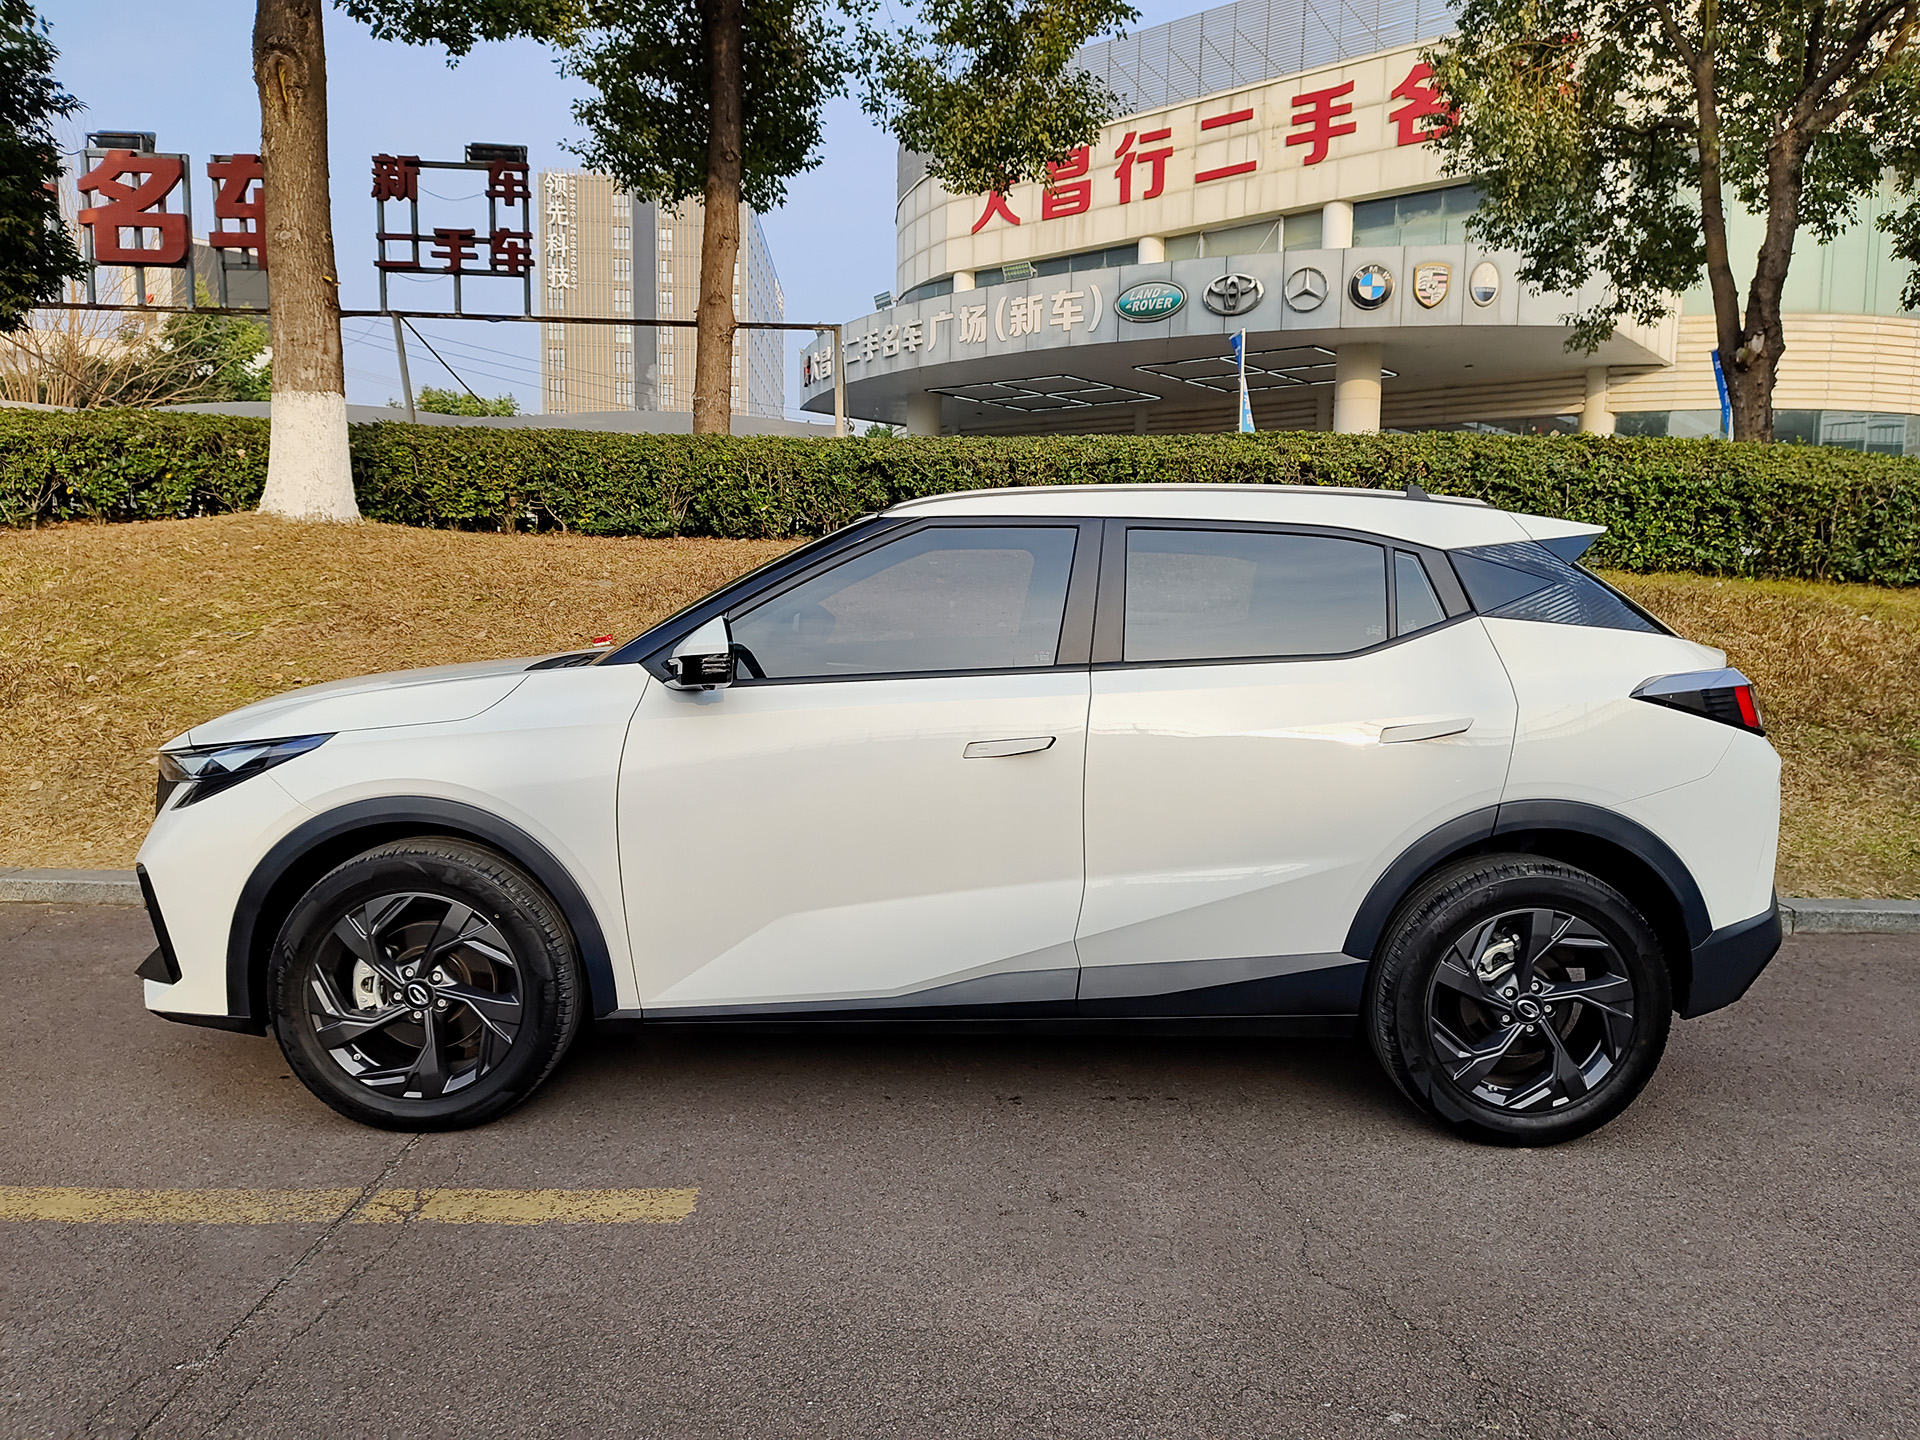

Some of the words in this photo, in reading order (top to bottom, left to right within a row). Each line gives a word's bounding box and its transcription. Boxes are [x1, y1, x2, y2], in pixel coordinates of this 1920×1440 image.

[543, 171, 570, 290] 领先科技
[373, 228, 535, 274] 二手车
[1355, 265, 1391, 280] BMW
[1129, 288, 1161, 301] LAND
[1131, 297, 1173, 312] ROVER
[811, 284, 1104, 384] 大昌二手名车广场(新车)
